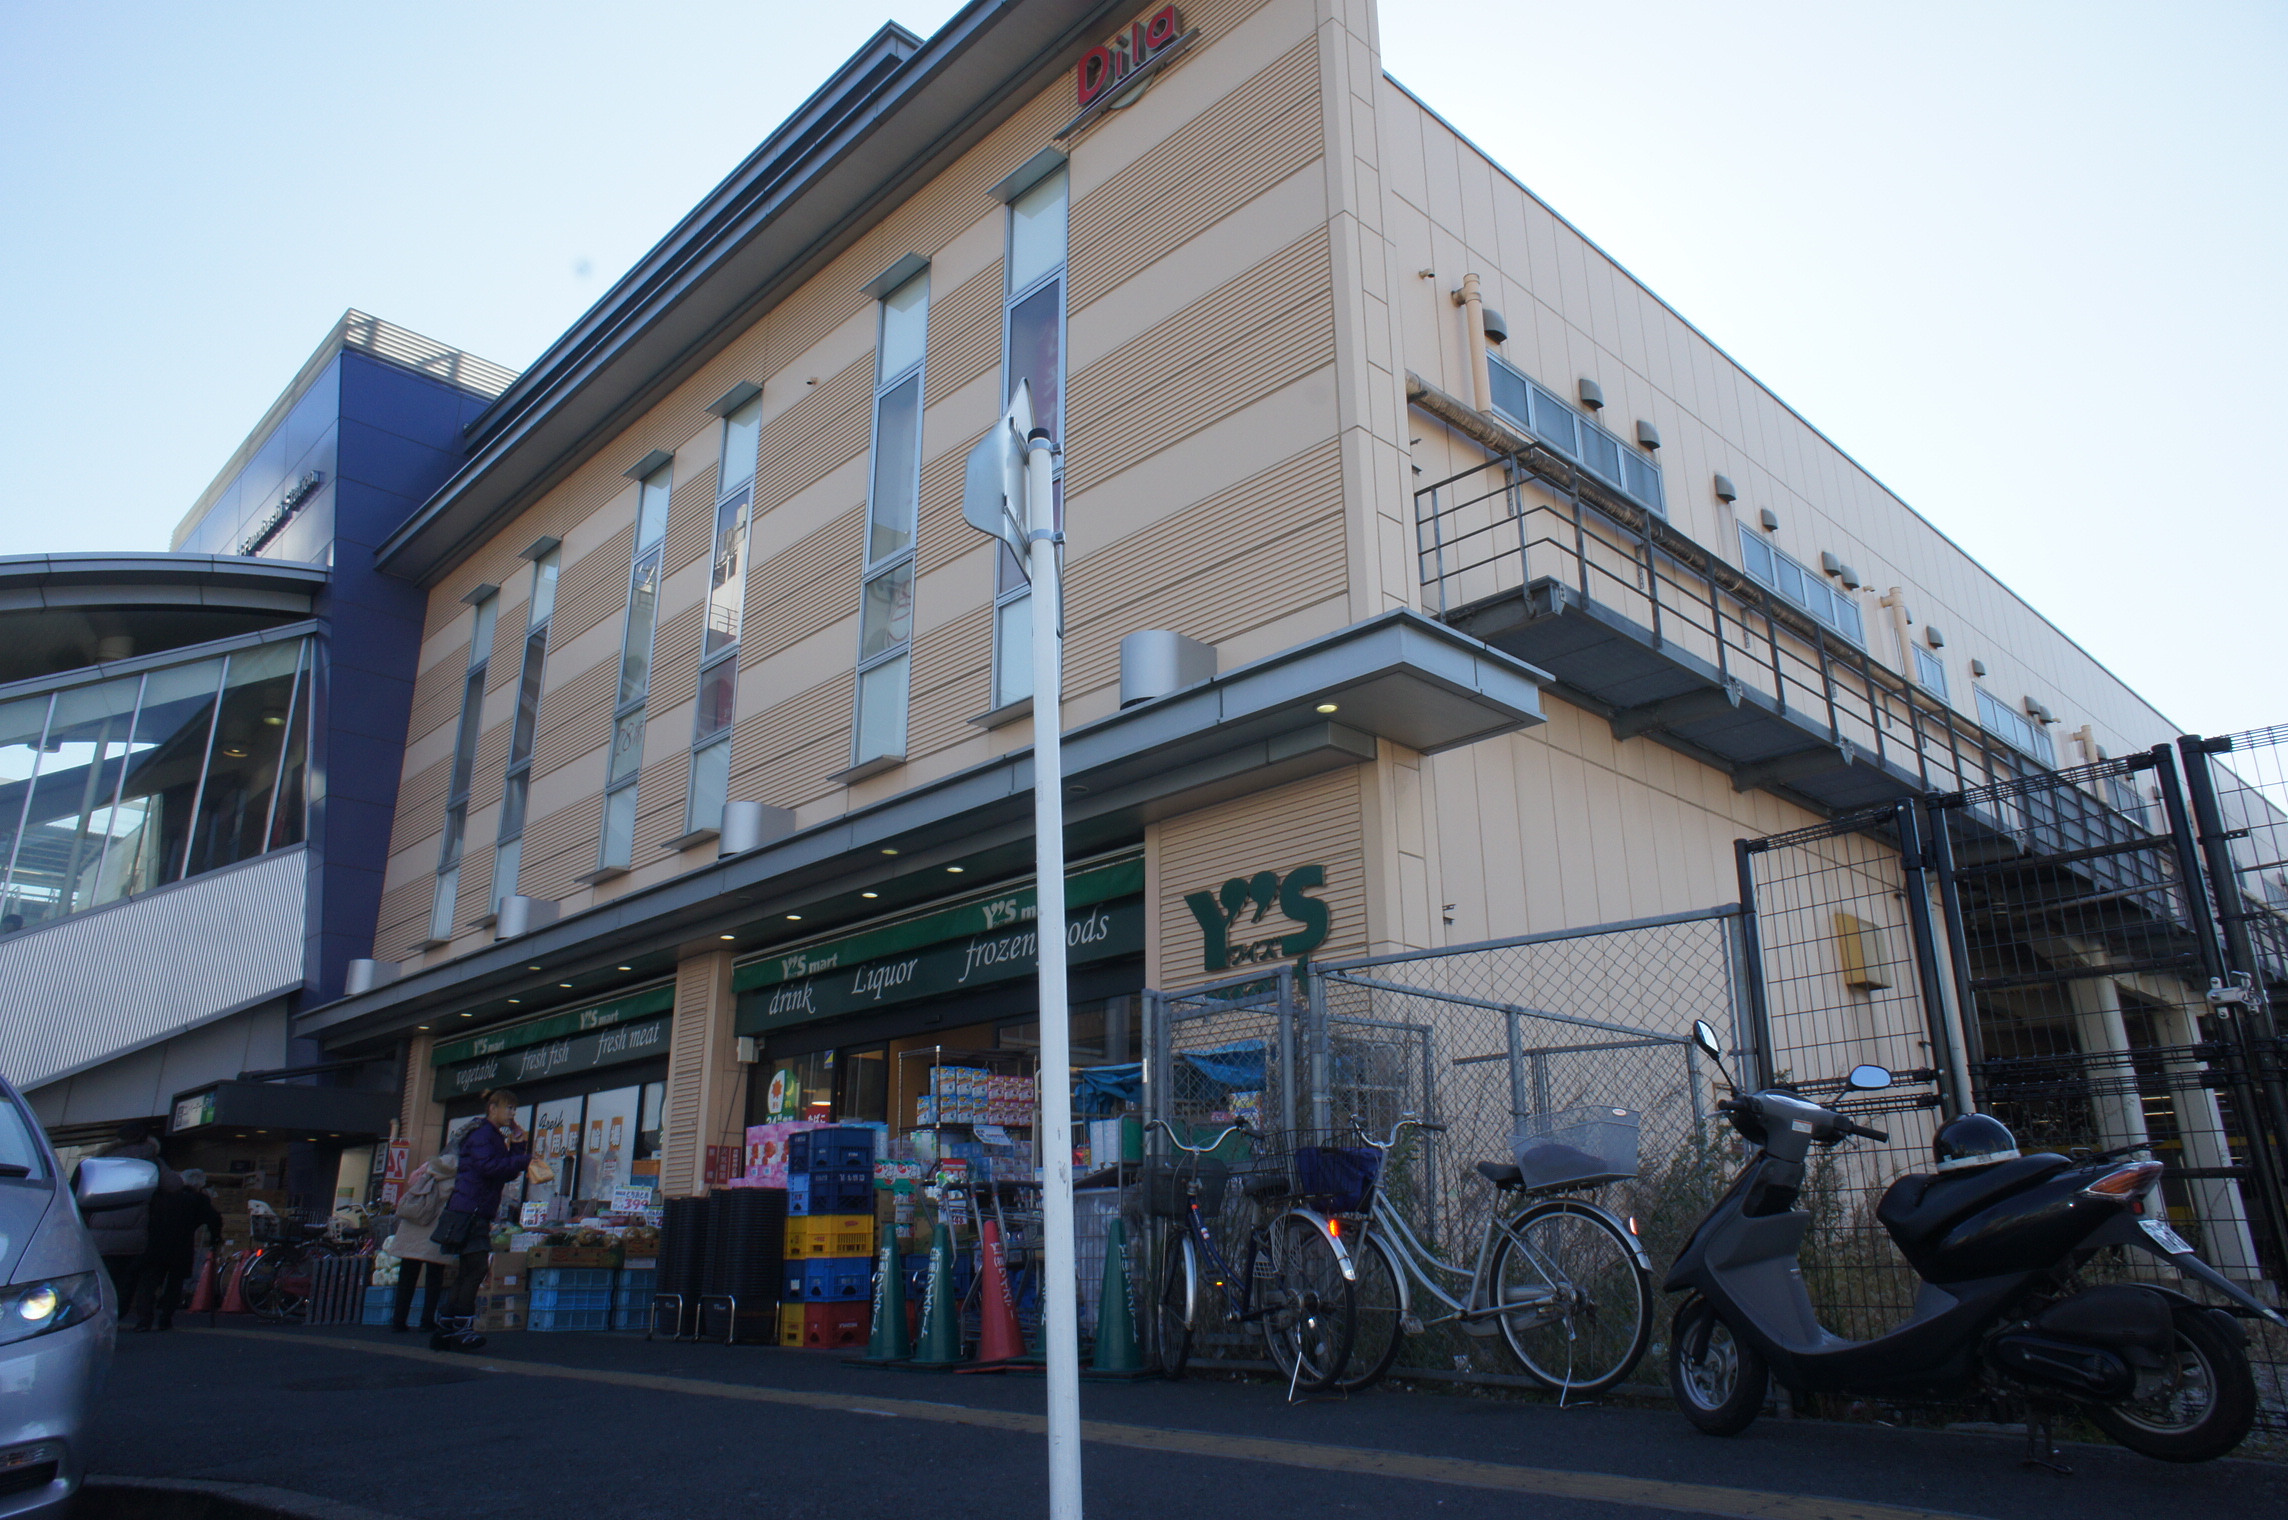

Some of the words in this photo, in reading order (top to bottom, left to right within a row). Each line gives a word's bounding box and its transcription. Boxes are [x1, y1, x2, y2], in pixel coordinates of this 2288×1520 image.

[1077, 4, 1180, 106] Dila
[808, 952, 838, 975] mart
[957, 934, 1036, 984] frozen
[1228, 936, 1283, 966] ワイズ
[767, 977, 816, 1016] drink
[851, 956, 918, 1001] Liquor
[598, 1009, 619, 1026] mart
[487, 1038, 505, 1054] mart
[516, 1044, 547, 1080] fresh
[543, 1037, 570, 1075] fish
[592, 1024, 628, 1065] fresh
[628, 1022, 660, 1049] meat
[455, 1055, 498, 1092] vegetable
[807, 1113, 826, 1124] たばこ
